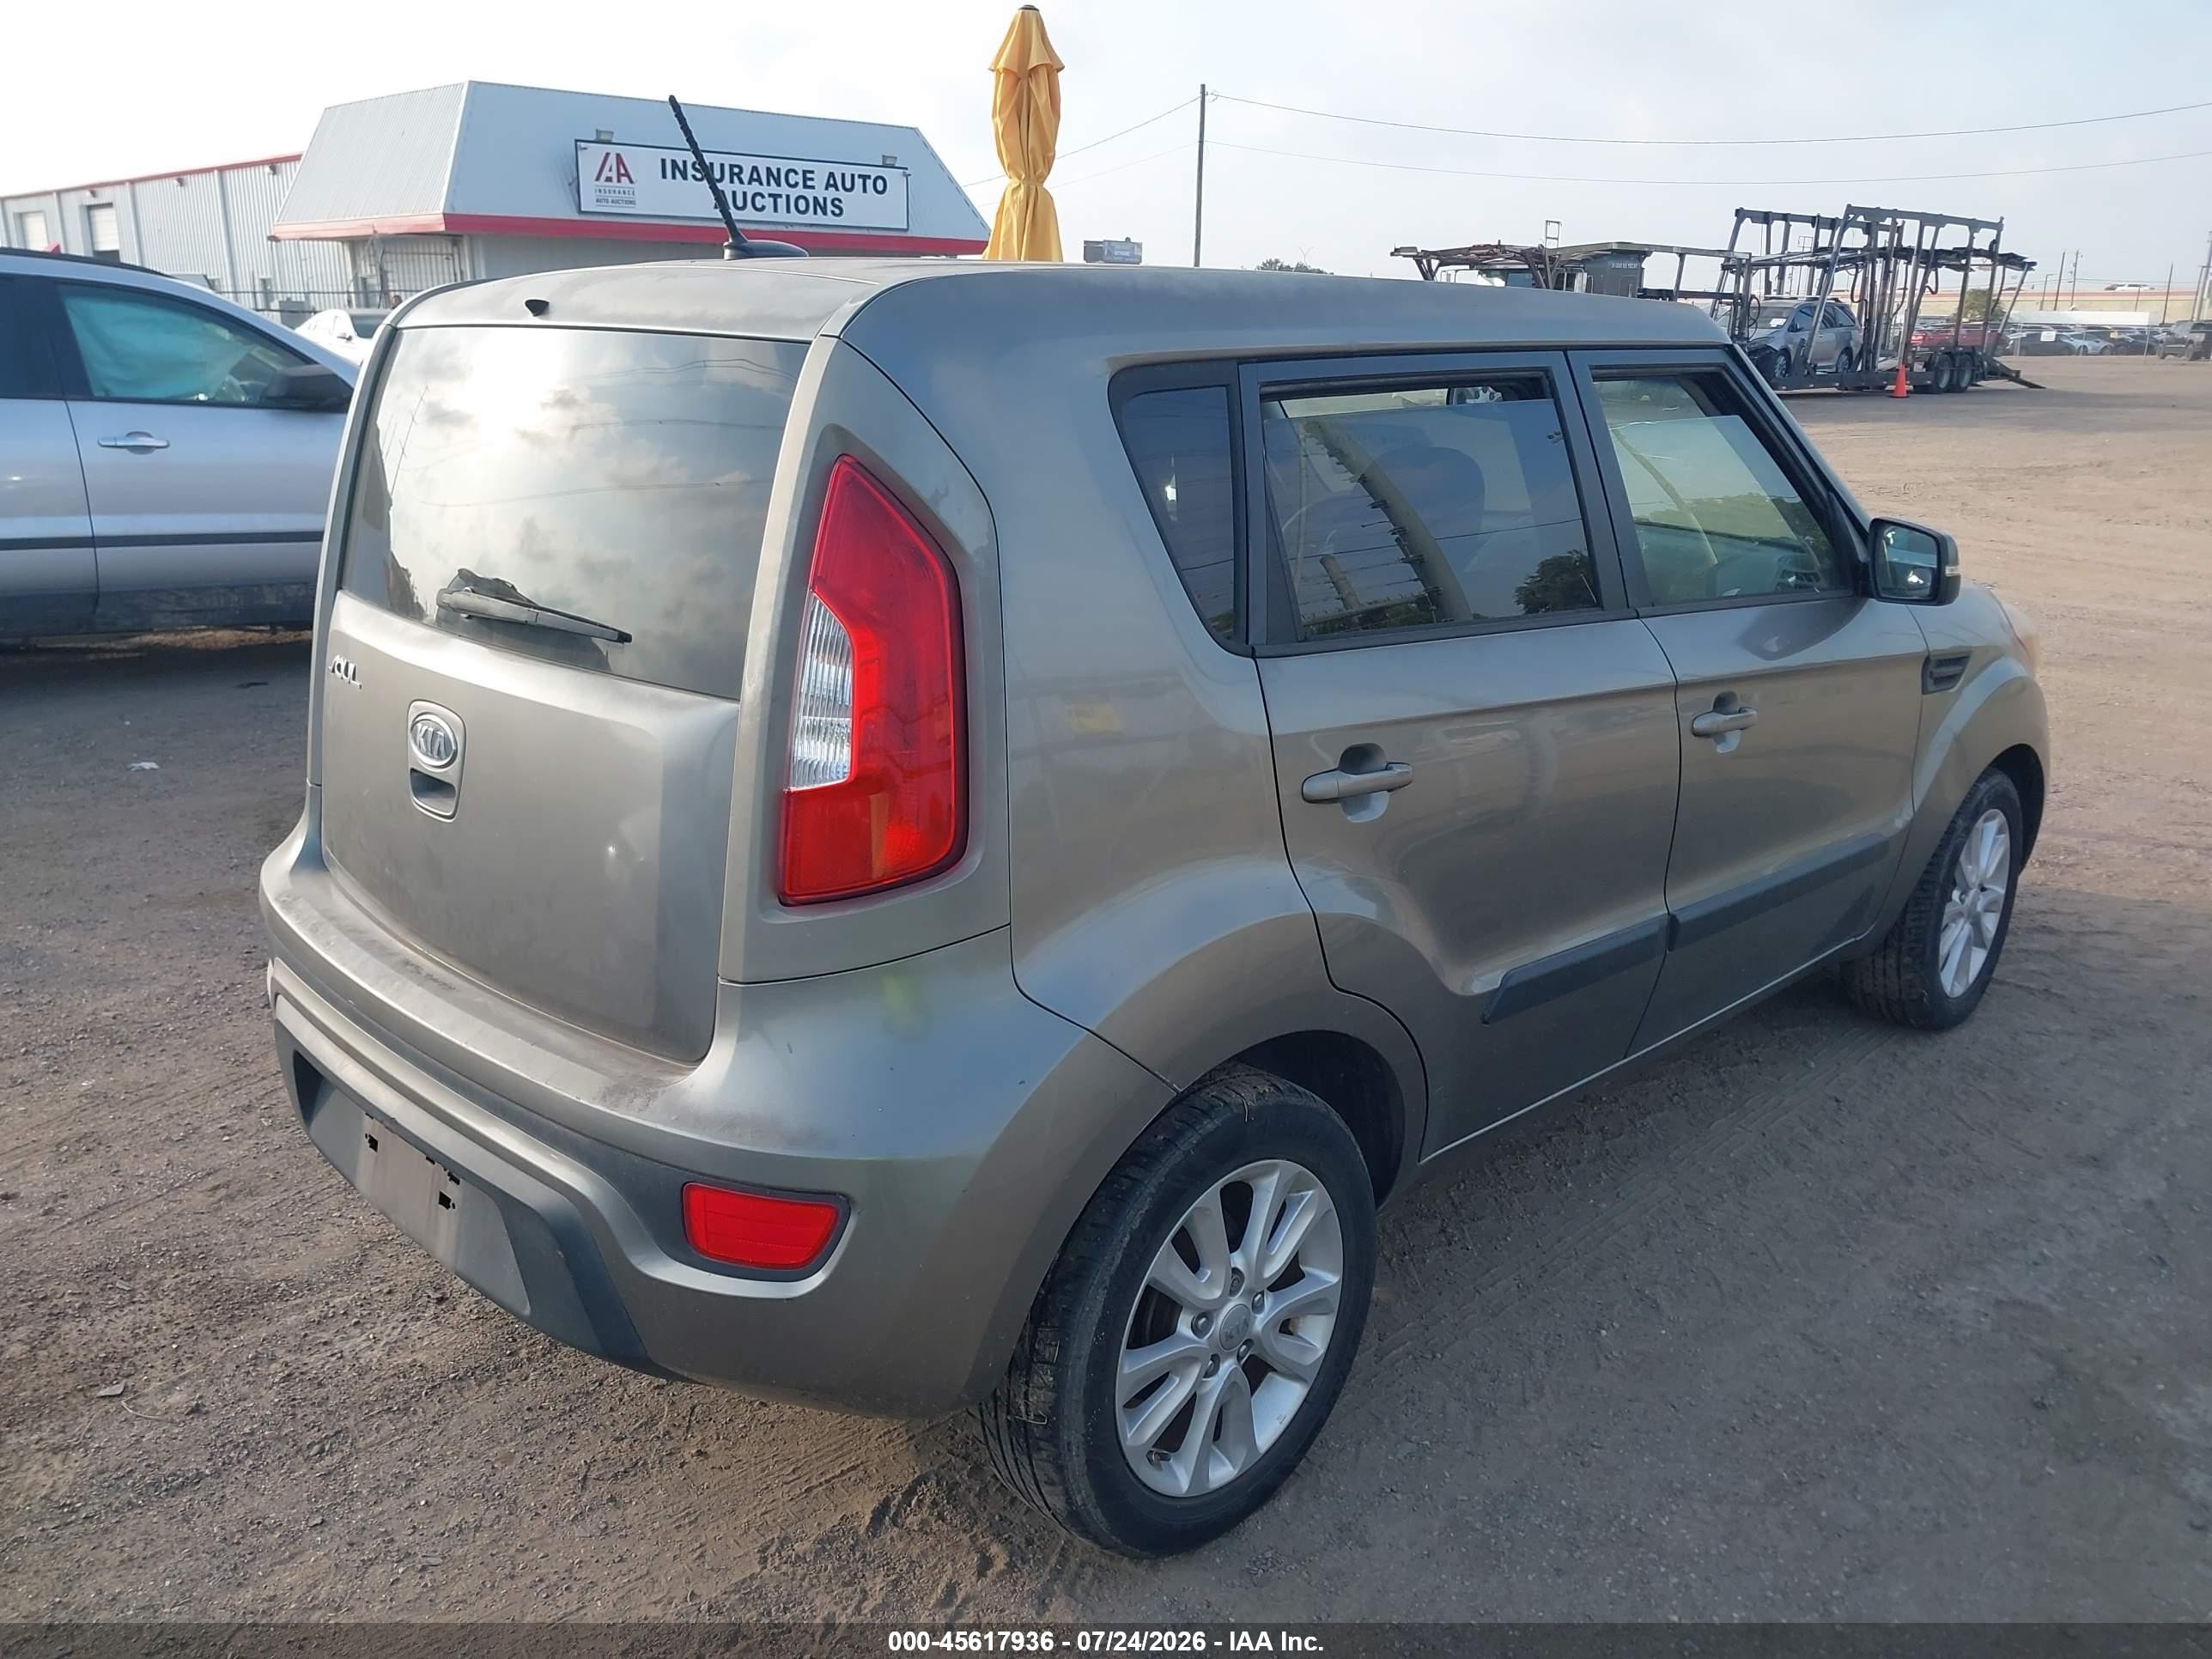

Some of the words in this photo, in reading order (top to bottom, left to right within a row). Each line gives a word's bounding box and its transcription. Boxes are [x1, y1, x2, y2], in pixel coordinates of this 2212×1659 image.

[594, 188, 635, 197] INSURANCE
[660, 158, 816, 190] INSURANCE
[824, 172, 888, 195] AUTO
[416, 722, 447, 760] KIA
